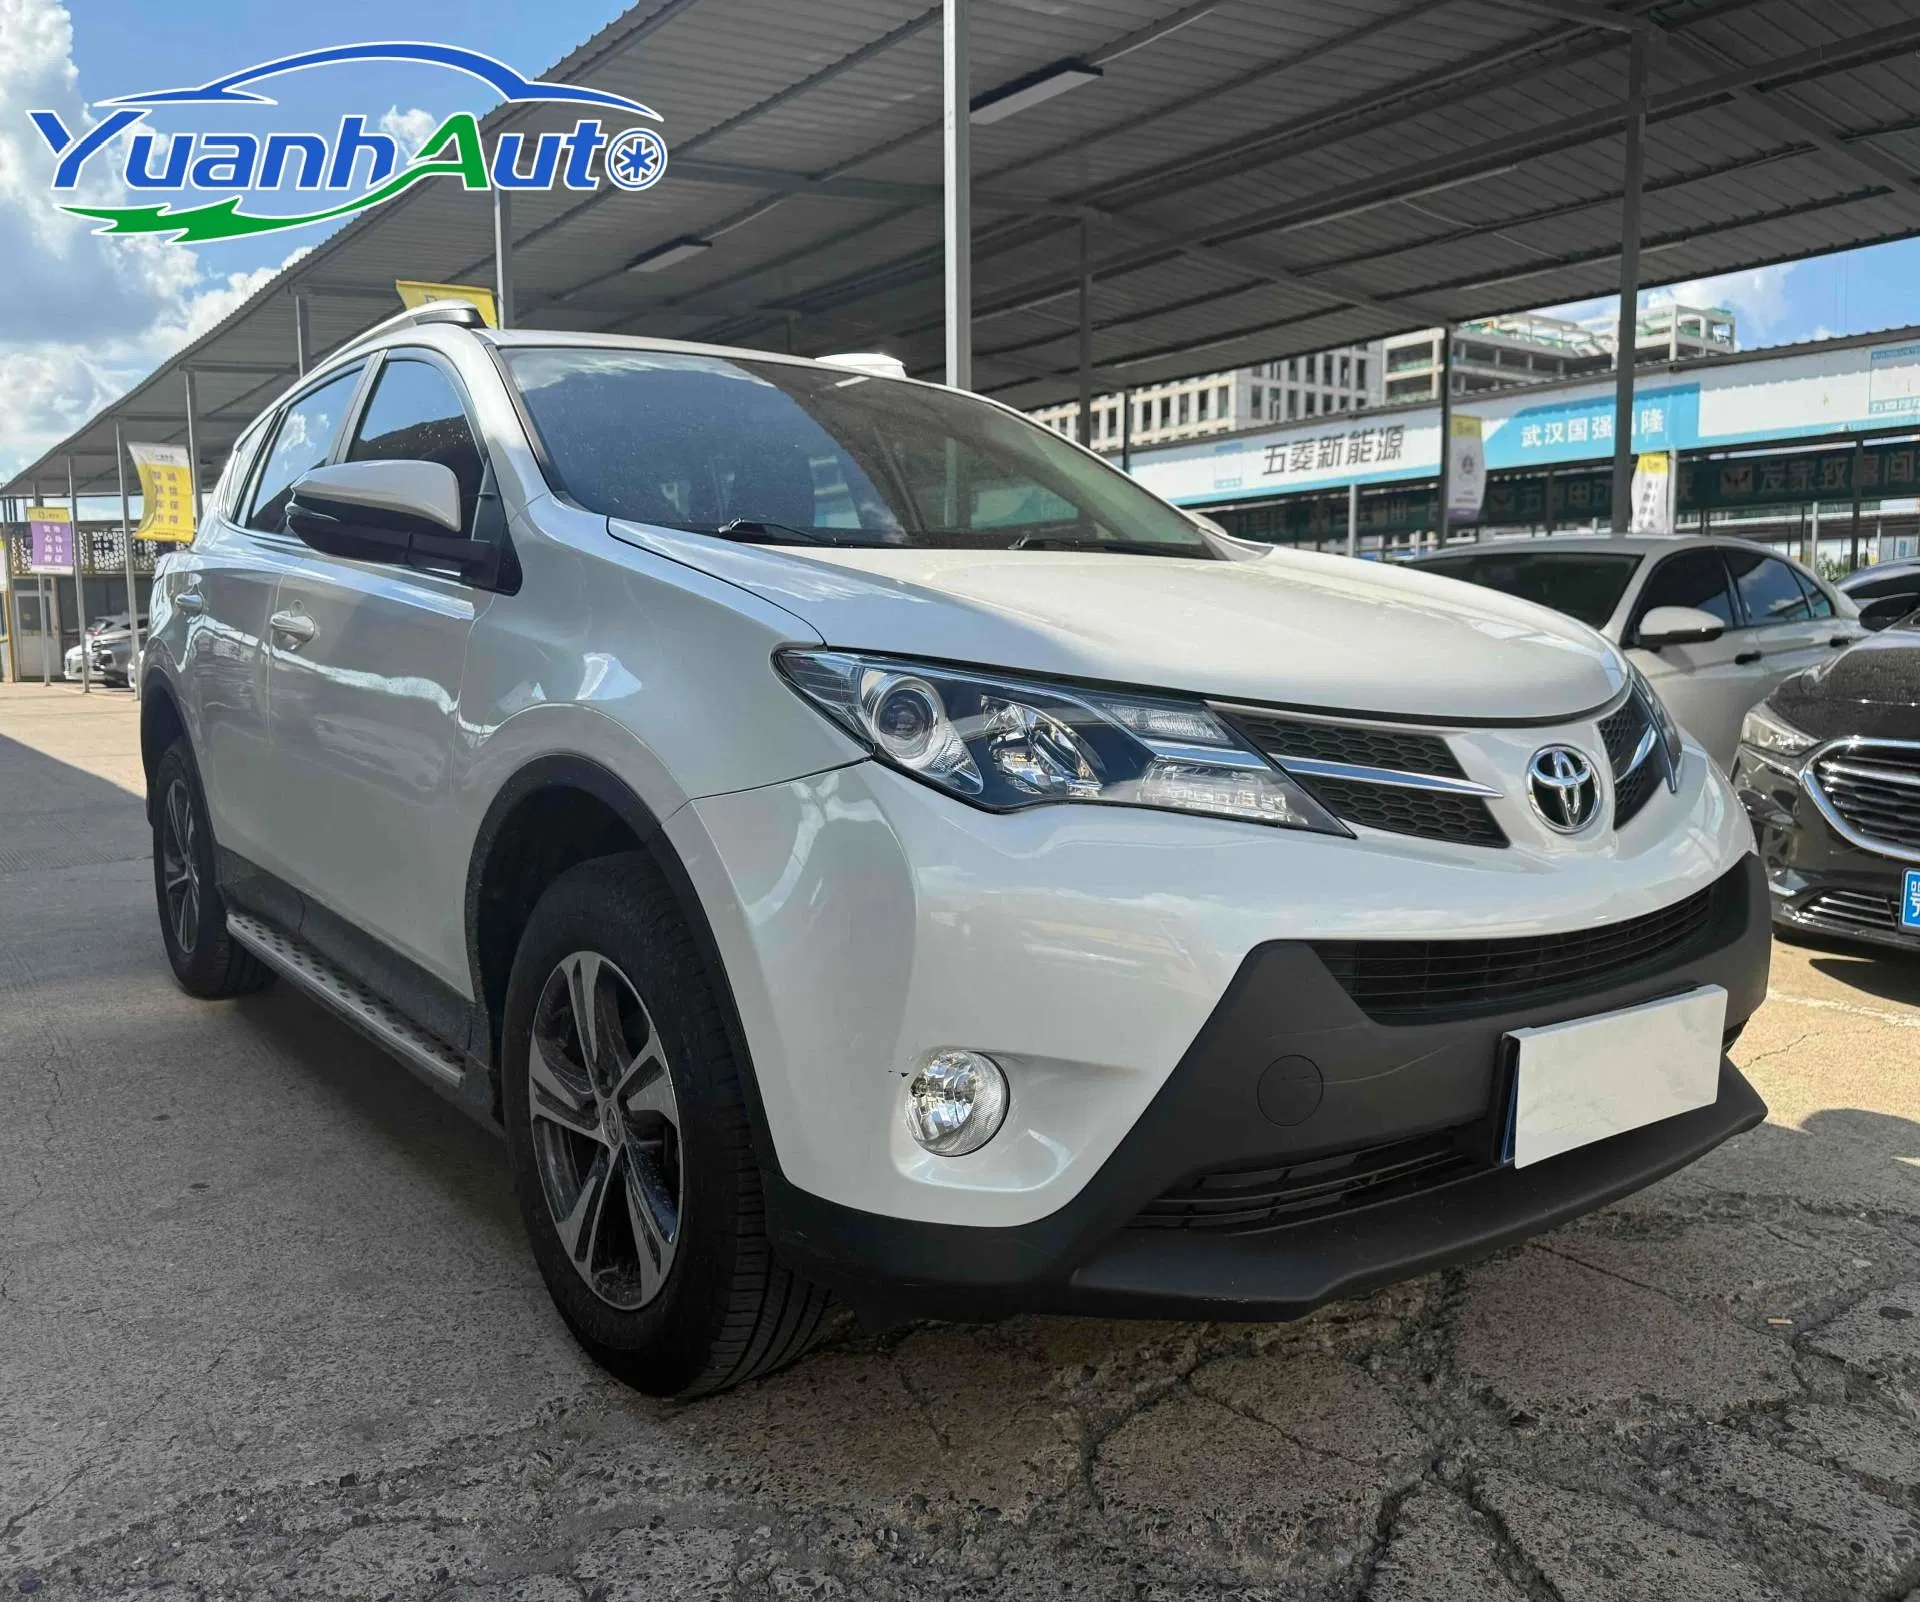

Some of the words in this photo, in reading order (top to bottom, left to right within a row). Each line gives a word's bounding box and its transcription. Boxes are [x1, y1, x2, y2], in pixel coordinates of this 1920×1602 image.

[1262, 424, 1405, 476] 五菱新能源
[1521, 408, 1665, 448] 武汉国强隆
